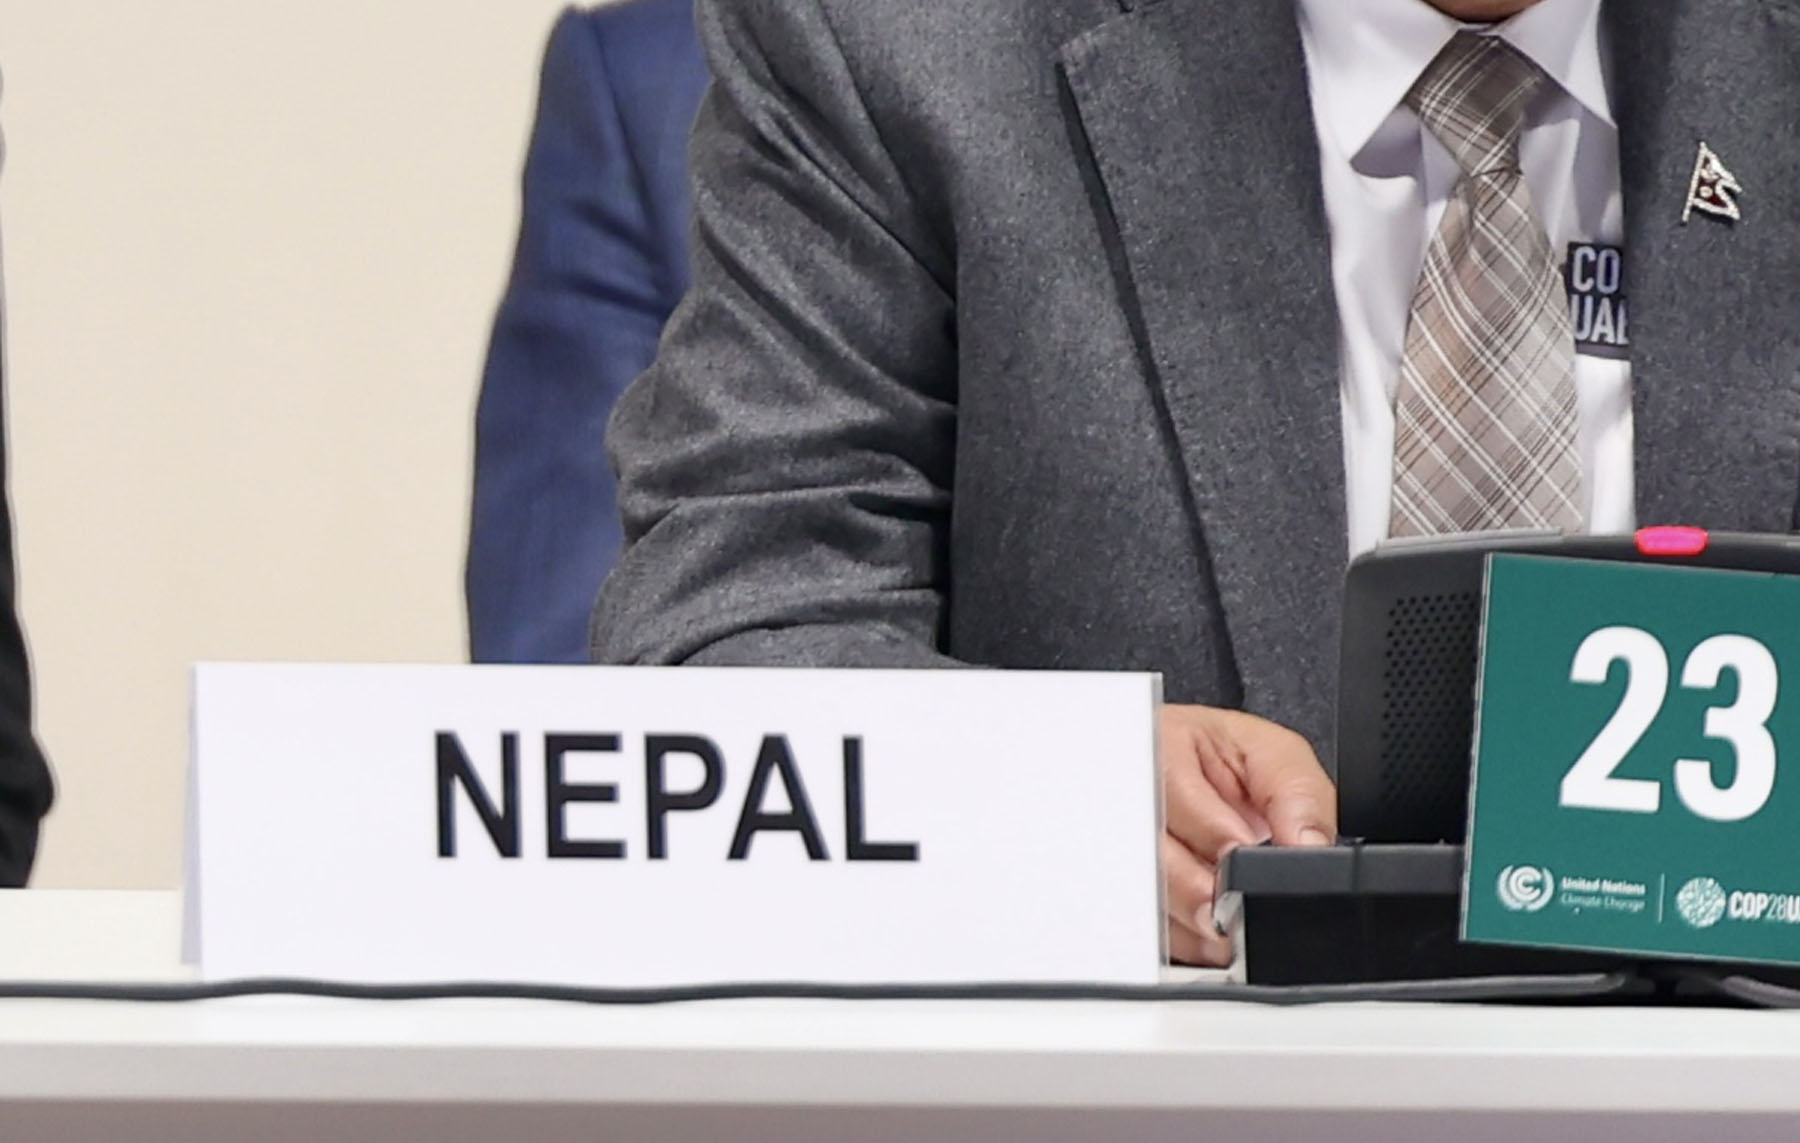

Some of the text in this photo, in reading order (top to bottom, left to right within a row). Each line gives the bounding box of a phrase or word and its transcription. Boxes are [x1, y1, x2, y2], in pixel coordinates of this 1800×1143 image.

[1559, 625, 1779, 822] 23
[434, 730, 920, 861] NEPAL
[1561, 892, 1645, 912] Climate Change
[1562, 876, 1646, 896] United Nations
